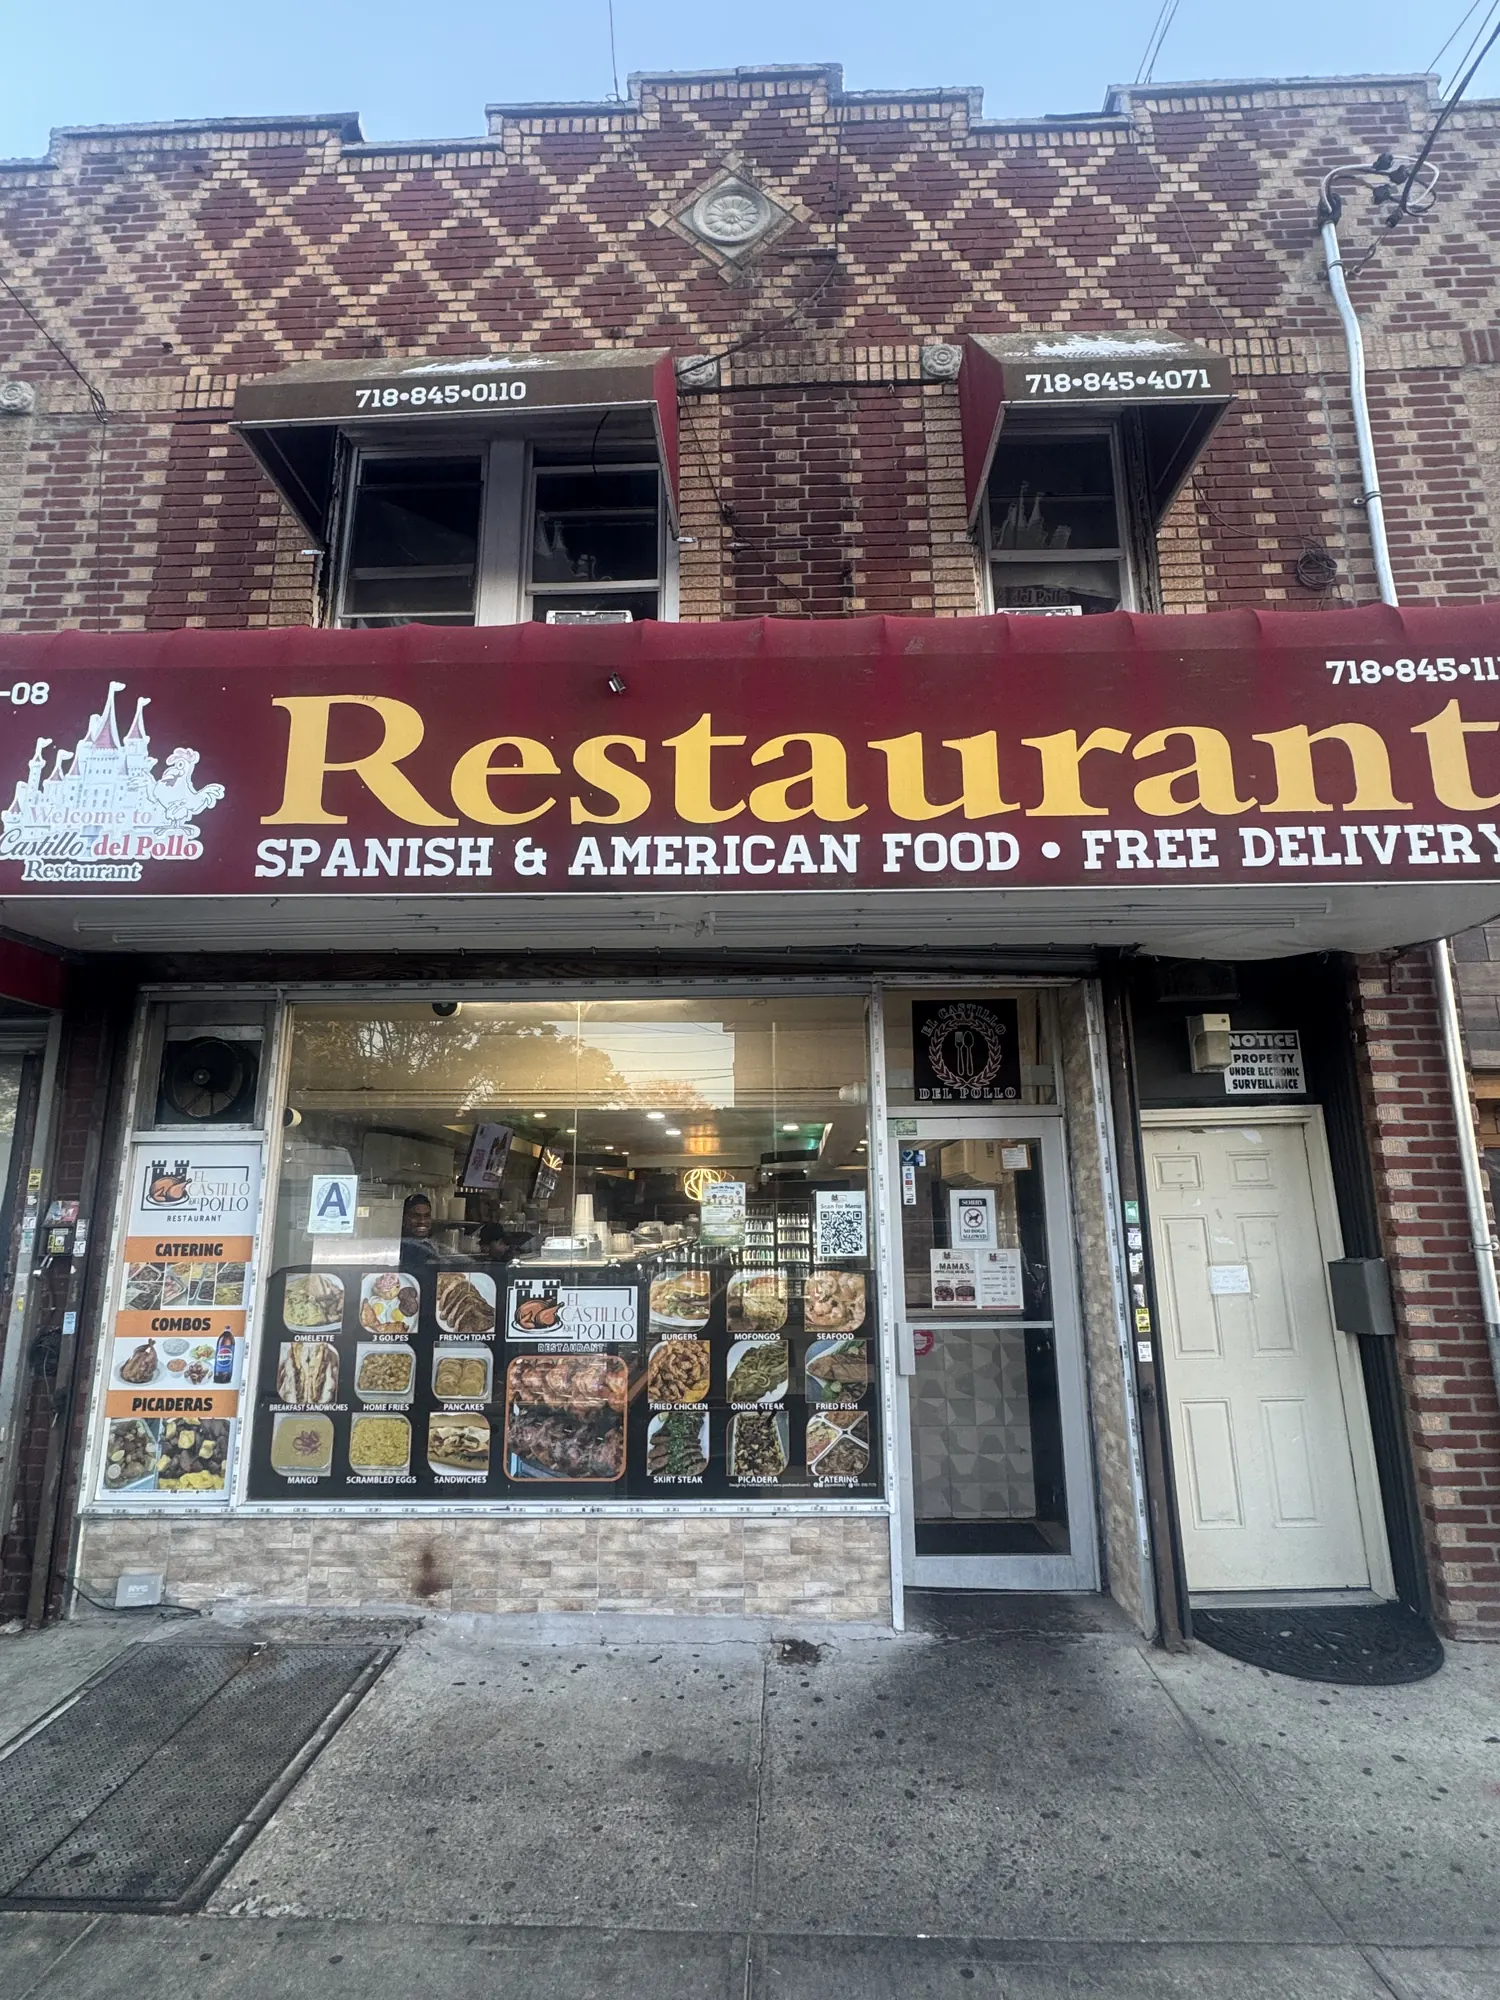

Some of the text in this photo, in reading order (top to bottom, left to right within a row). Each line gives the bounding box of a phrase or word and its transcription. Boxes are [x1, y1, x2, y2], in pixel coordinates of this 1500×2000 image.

[260, 694, 1500, 827] Restaurant
[30, 807, 153, 825] Welcome to
[0, 828, 198, 857] Castillo del Pollo
[255, 822, 1500, 878] SPANISH & AMERICAN FOOD FREE DELIVERY
[25, 859, 140, 879] Restaurant
[920, 1003, 1007, 1037] EL CASTILLO
[1229, 1034, 1296, 1047] NOTICE
[1229, 1066, 1256, 1076] UNDER
[1232, 1078, 1299, 1090] SURVEILLANCE
[918, 1086, 1017, 1099] DEL POLLO
[194, 1170, 208, 1183] EL
[188, 1182, 250, 1197] CASTILLO
[199, 1196, 249, 1212] POLLO
[317, 1182, 348, 1217] A
[166, 1214, 223, 1223] RESTAURANT
[155, 1243, 224, 1257] CATERING
[566, 1293, 582, 1306] EL
[561, 1306, 635, 1322] CASTILLO
[151, 1317, 212, 1331] COMBOS
[576, 1323, 634, 1340] POLLO
[293, 1334, 335, 1342] OMELETTE
[372, 1334, 409, 1342] 3 GOLPES
[471, 1333, 496, 1341] TOAST
[661, 1333, 698, 1341] BURGERS
[734, 1333, 781, 1341] MOFONGOS
[816, 1333, 855, 1341] SEAFOOD
[537, 1342, 605, 1353] RESTAURANT
[131, 1397, 213, 1412] PICADERAS
[269, 1403, 349, 1412] BREAKFAST SANDWICHES
[363, 1403, 410, 1411] HOME FRIES
[443, 1403, 485, 1411] PANCAKES
[649, 1403, 709, 1411] FRIED CHICKEN
[731, 1402, 785, 1411] ONION STEAK
[816, 1402, 858, 1410] FRIED FISH
[287, 1476, 319, 1485] MANGU
[346, 1476, 417, 1484] SCRAMBLED EGGS
[434, 1476, 487, 1484] SANDWICHES
[653, 1476, 703, 1484] SKIRT STEAK
[738, 1475, 779, 1484] PICADERA
[818, 1475, 859, 1484] CATERING
